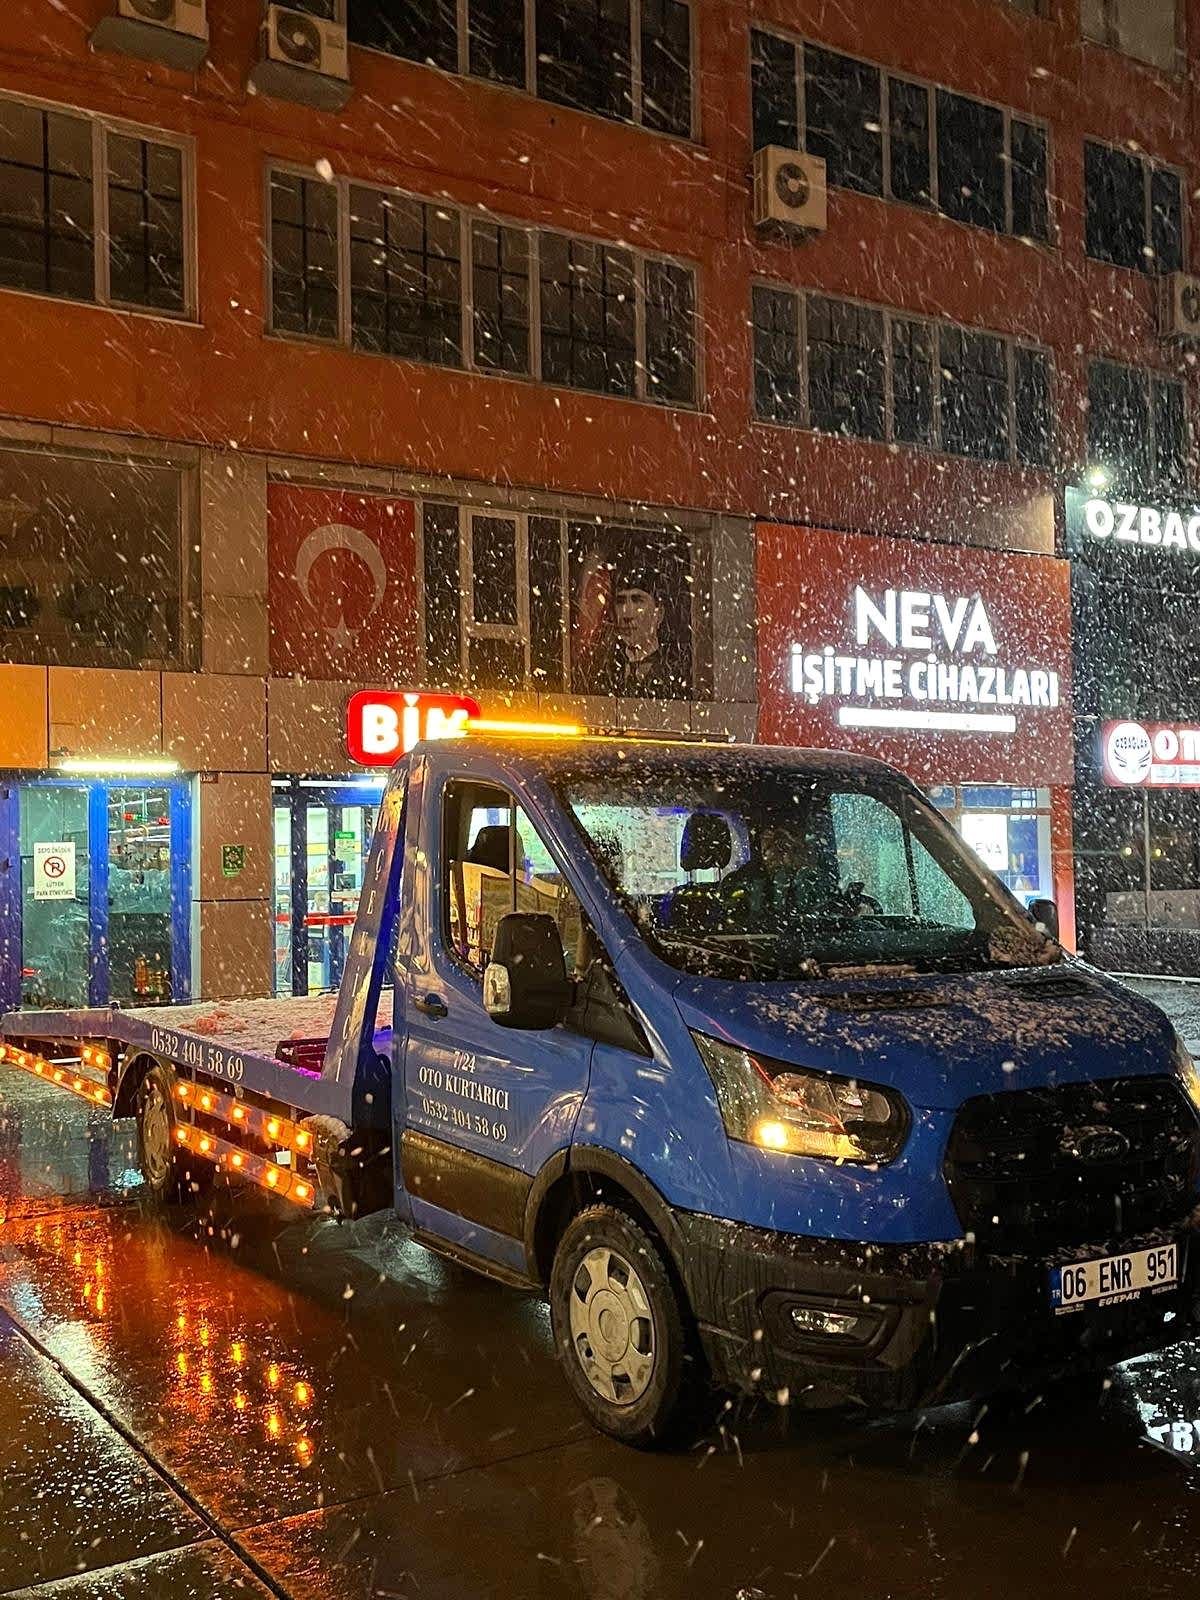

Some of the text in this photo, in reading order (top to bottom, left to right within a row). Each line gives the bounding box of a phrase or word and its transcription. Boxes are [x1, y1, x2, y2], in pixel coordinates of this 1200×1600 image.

[855, 585, 998, 654] NEVA
[791, 643, 1059, 707] İŞİTME CİHAZLARI
[362, 693, 469, 754] BİM
[152, 1028, 244, 1081] 0532 404 58 69
[453, 1050, 476, 1074] 7/24
[419, 1066, 510, 1111] OTO KURTARICI
[422, 1097, 508, 1142] 0532 404 58 69
[1063, 1247, 1175, 1301] 06 ENR 951
